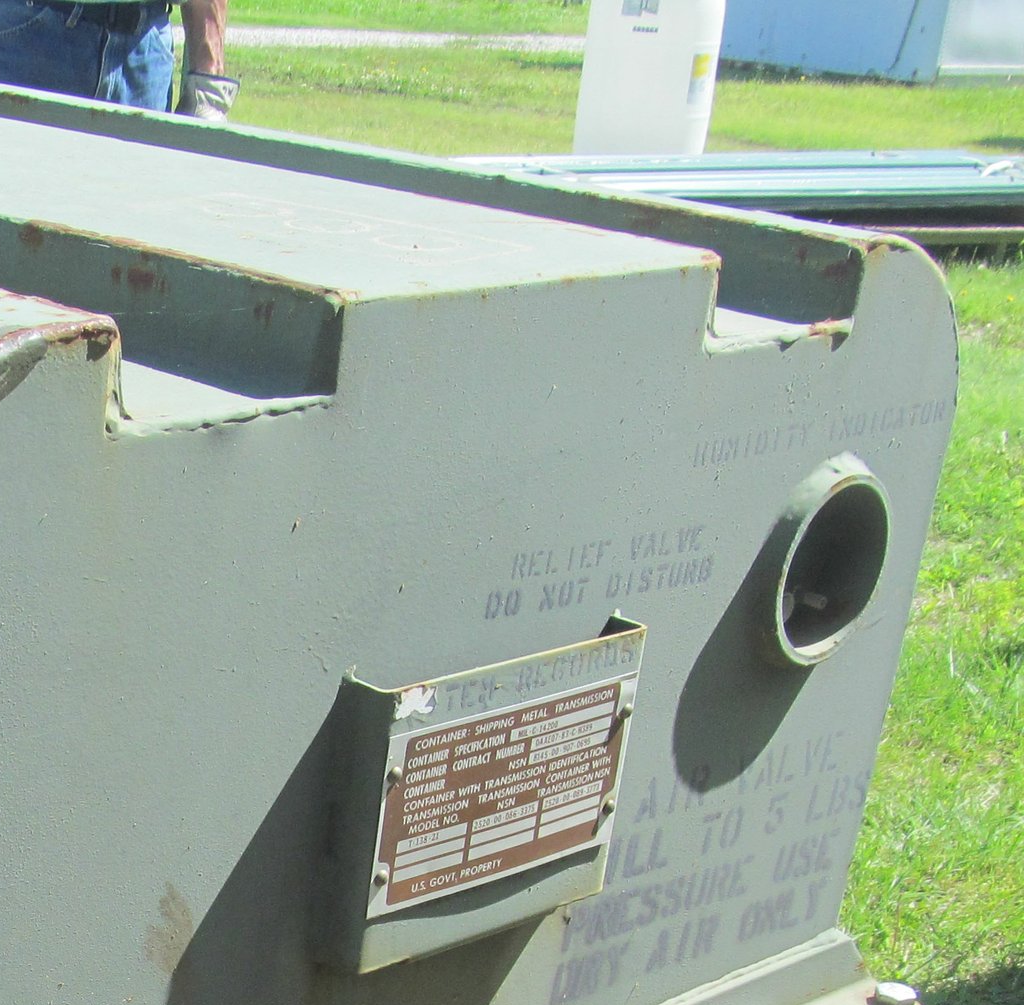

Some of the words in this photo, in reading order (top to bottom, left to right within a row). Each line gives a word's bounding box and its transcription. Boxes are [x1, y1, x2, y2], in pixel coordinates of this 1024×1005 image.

[692, 422, 812, 469] HUMIDITY
[829, 399, 948, 443] INDICATOR
[510, 539, 612, 581] RELIEF
[630, 524, 707, 563] VALVE
[484, 588, 521, 620] DO
[538, 576, 590, 612] NOT
[606, 556, 716, 599] DISTURB
[407, 748, 450, 769] CONTAINER
[454, 734, 506, 757] SPECIFICATION
[415, 728, 471, 751] CONTAINER:
[475, 716, 515, 736] SHIPPING
[521, 707, 548, 723] METAL
[555, 688, 613, 714] TRANSMISSION
[402, 799, 469, 825] TRANSMISSION
[478, 778, 541, 804] TRANSMISSION
[545, 763, 590, 784] CONTAINER
[592, 754, 612, 769] WITH
[403, 790, 455, 812] CONTAINER
[458, 783, 481, 797] WITH
[485, 764, 547, 790] TRANSMISSION
[548, 745, 608, 772] IDENTIFICATION
[404, 779, 446, 800] CONTAINER
[508, 758, 527, 771] NSN
[405, 764, 448, 784] CONTAINER
[452, 751, 492, 772] CONTRACT
[495, 742, 525, 760] NUMBER
[633, 763, 713, 825] AIR
[737, 729, 846, 796] VALVE
[408, 819, 440, 835] MODEL
[443, 813, 459, 826] NO.
[496, 797, 516, 811] NSN
[537, 774, 594, 799] TRANSMISSION
[594, 767, 610, 780] NSN
[604, 828, 668, 886] ILL
[700, 805, 746, 855] TO
[764, 791, 790, 835] 5
[804, 768, 873, 826] LBS
[411, 882, 427, 893] U.S.
[460, 857, 503, 879] PROPERTY
[560, 854, 756, 953] PRESSURE
[773, 828, 842, 884] USE
[644, 912, 723, 974] AIR
[737, 876, 830, 943] ONLY
